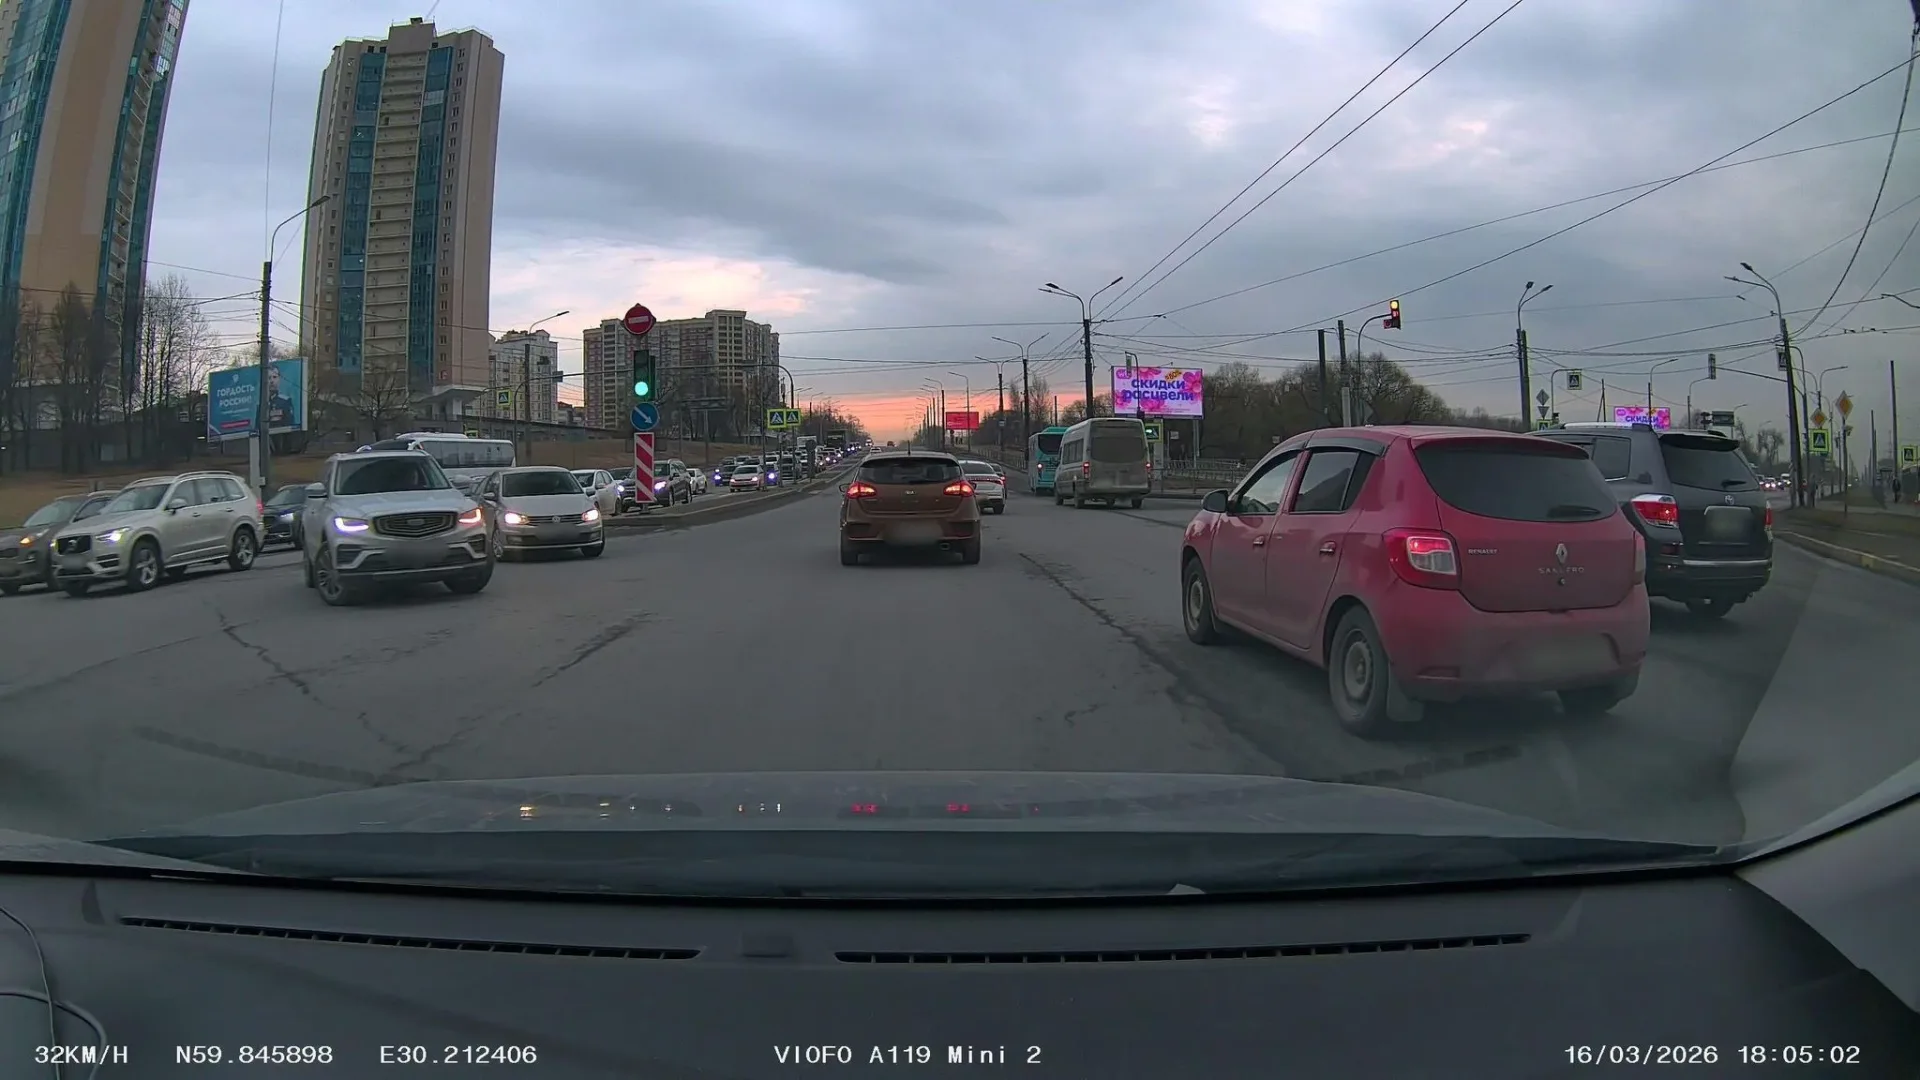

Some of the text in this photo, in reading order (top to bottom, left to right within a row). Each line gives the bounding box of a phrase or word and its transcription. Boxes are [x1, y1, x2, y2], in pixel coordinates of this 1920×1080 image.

[1131, 379, 1185, 390] скидки
[217, 384, 255, 397] ГОРДОСТЬ
[1538, 566, 1585, 574] SANERO
